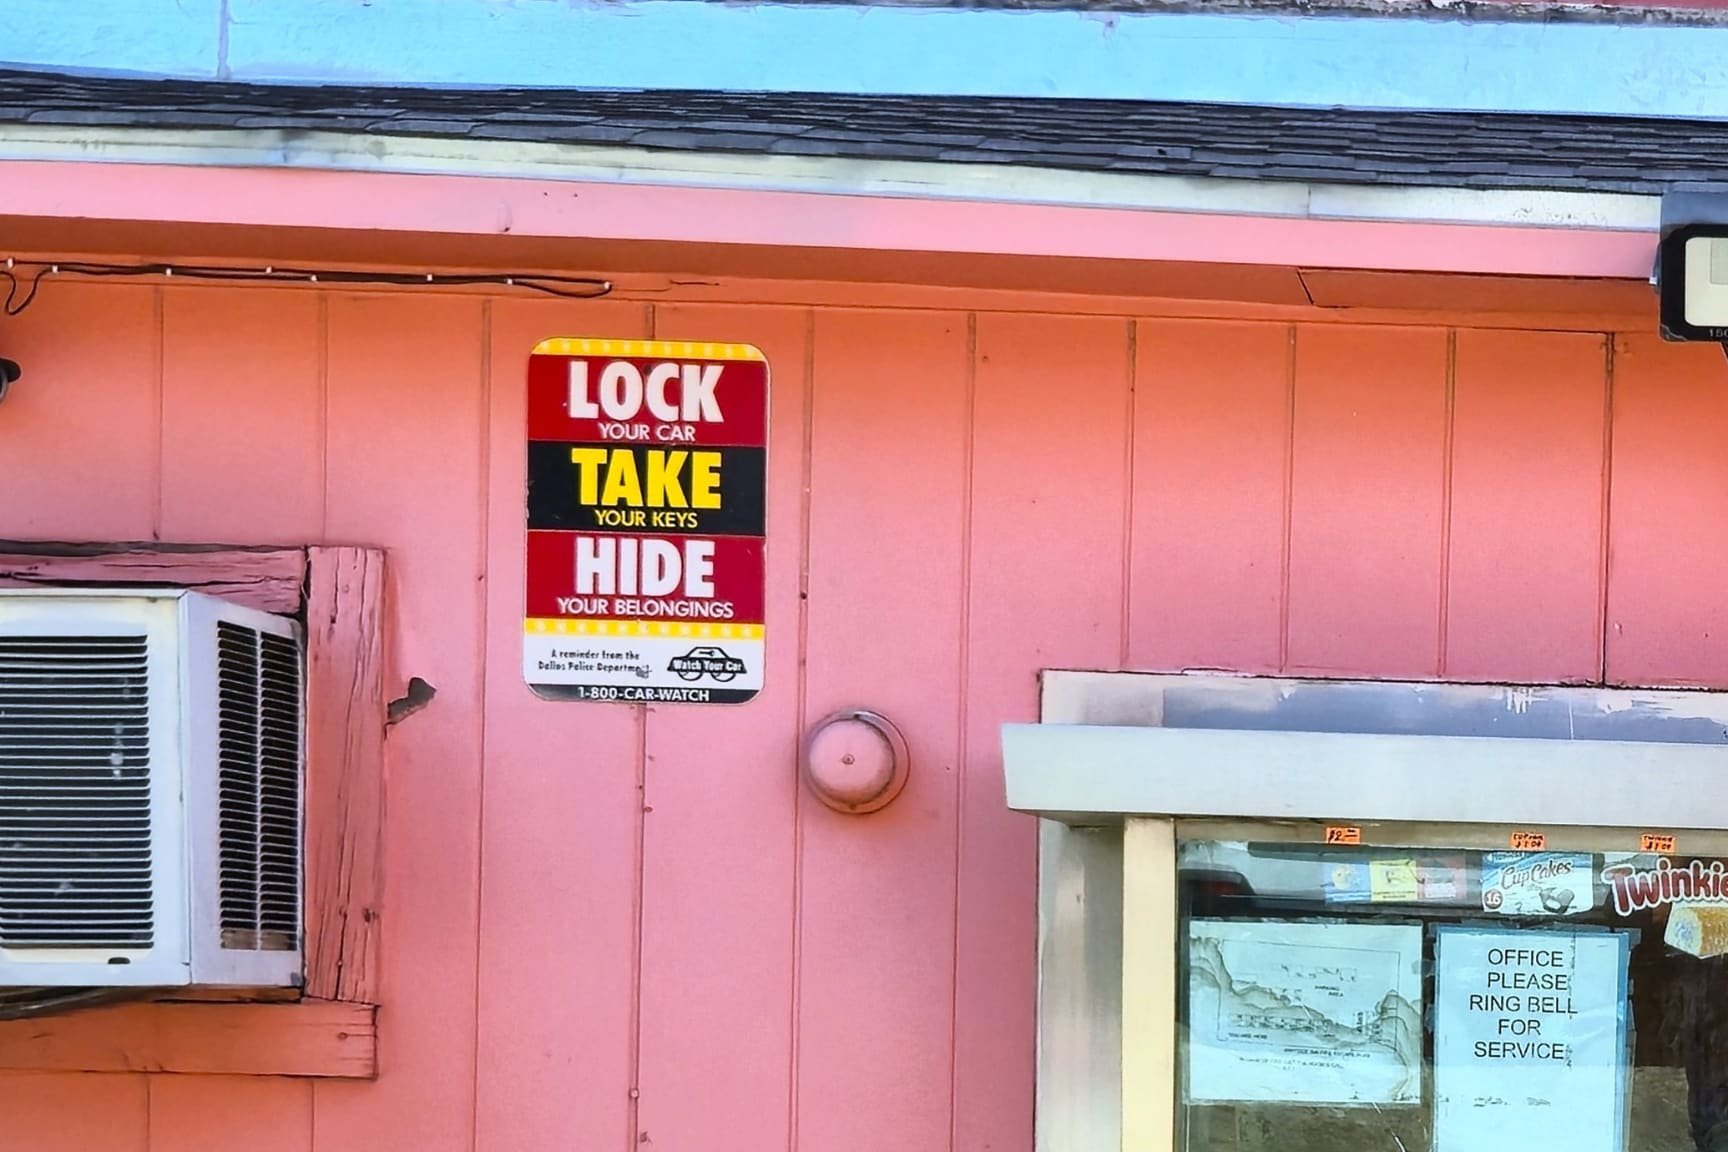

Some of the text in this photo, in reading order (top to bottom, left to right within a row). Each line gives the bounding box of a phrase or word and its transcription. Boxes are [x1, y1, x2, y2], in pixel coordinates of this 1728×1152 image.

[568, 360, 725, 423] LOCK
[599, 423, 696, 443] YOUR CAR
[571, 447, 722, 510] TAKE
[594, 509, 698, 529] YOUR KEYS
[576, 537, 716, 599] HIDE
[558, 597, 735, 619] YOUR BELONGINGS
[551, 649, 640, 661] A reminder from the
[538, 660, 594, 672] Dallas Police
[673, 658, 742, 672] Watch Your Car
[577, 686, 710, 702] 1-800-CAR-WATCH
[1486, 893, 1501, 903] 16
[1488, 948, 1564, 967] OFFICE
[1488, 972, 1567, 990] PLEASE
[1470, 994, 1578, 1014] RING BELL
[1498, 1019, 1541, 1036] FOR
[1474, 1041, 1565, 1060] SERVICE
